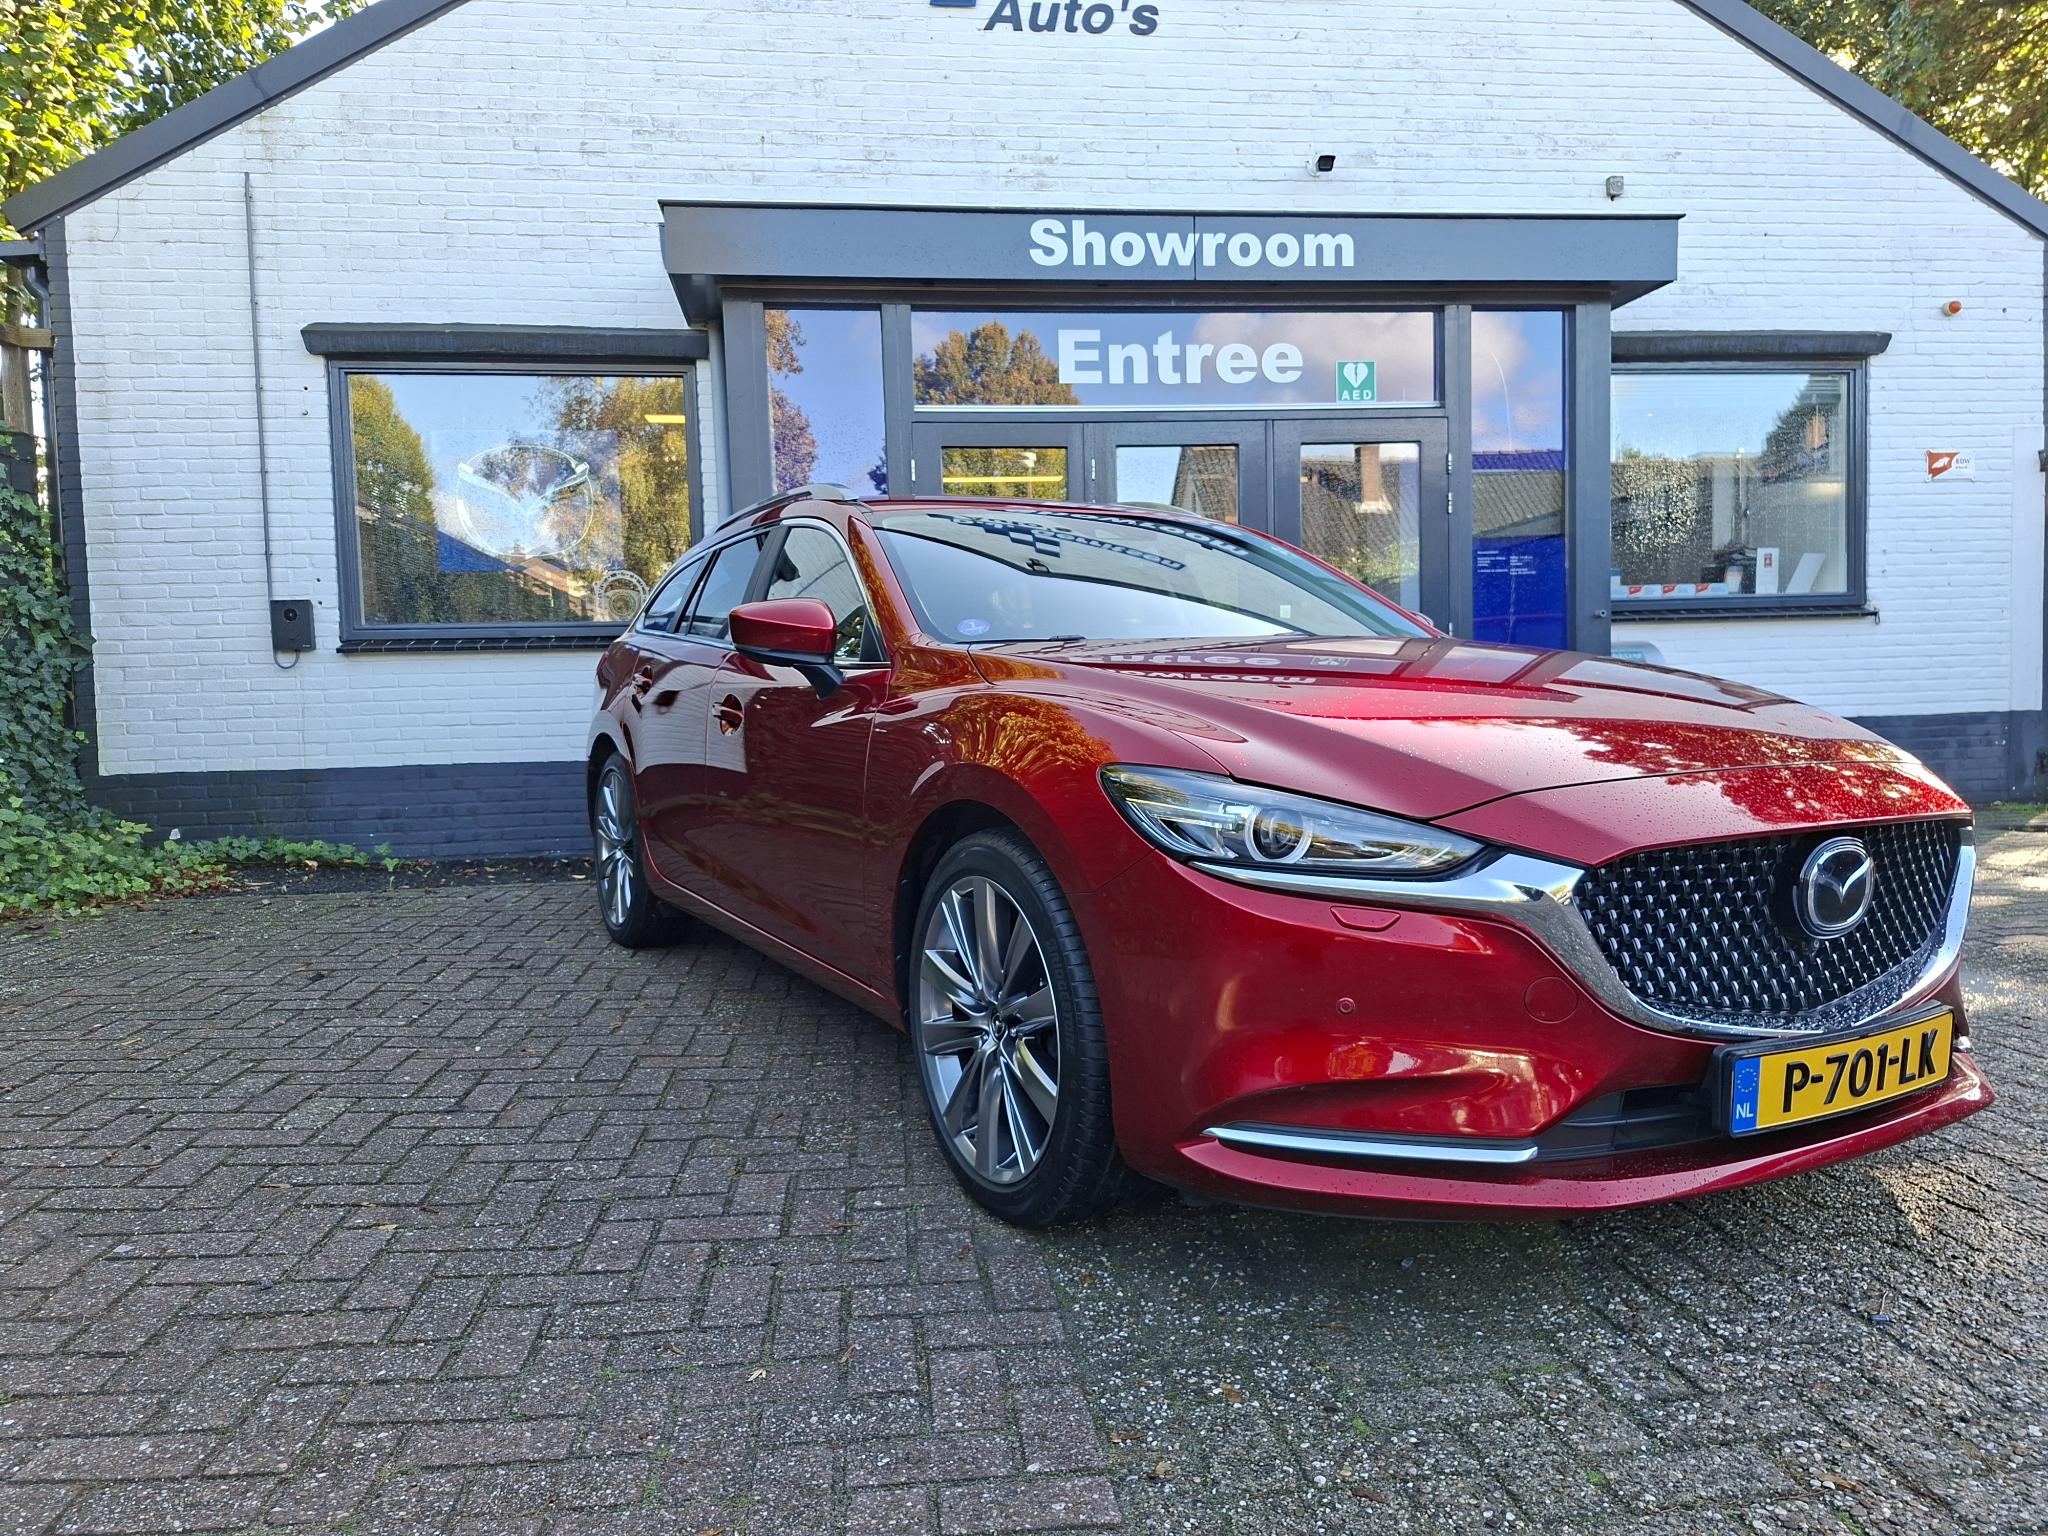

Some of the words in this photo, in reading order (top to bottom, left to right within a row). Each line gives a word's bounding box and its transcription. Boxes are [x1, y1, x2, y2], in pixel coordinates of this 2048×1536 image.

[984, 0, 1159, 35] Auto's
[1029, 219, 1354, 267] Showroom
[1057, 329, 1303, 385] Entree
[1341, 390, 1372, 401] AED
[1783, 1028, 1939, 1113] P-701-LK
[1736, 1103, 1754, 1119] NL
